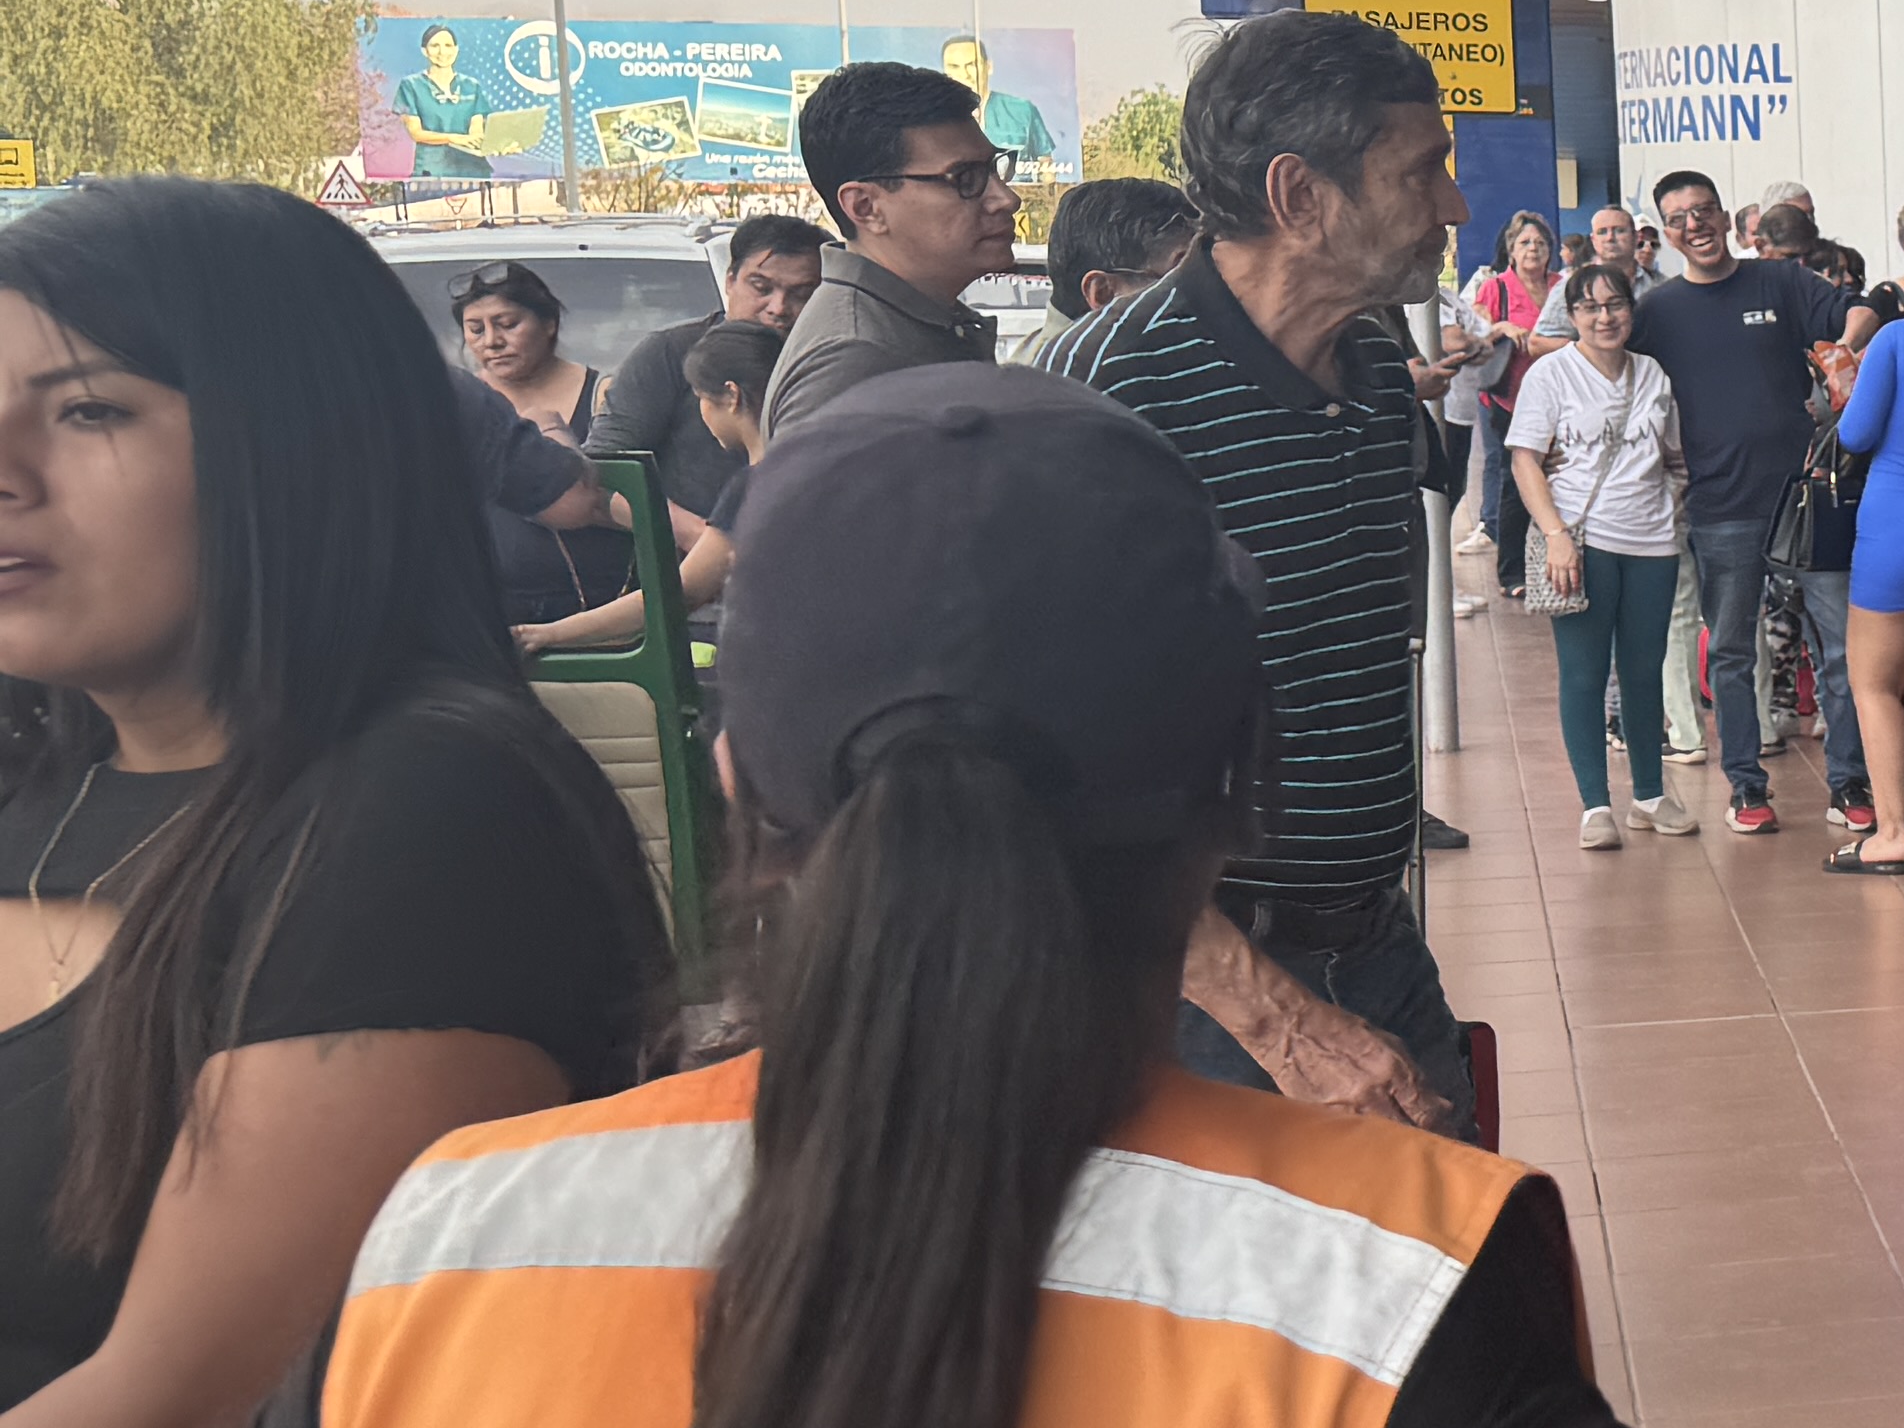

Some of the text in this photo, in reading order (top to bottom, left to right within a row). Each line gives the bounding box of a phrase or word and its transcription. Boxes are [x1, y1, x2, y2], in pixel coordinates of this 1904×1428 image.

[1331, 10, 1488, 32] SAJEROS
[588, 41, 669, 60] ROCHA
[686, 42, 783, 62] PEREIRA
[619, 61, 753, 79] ODONTOLOGIA
